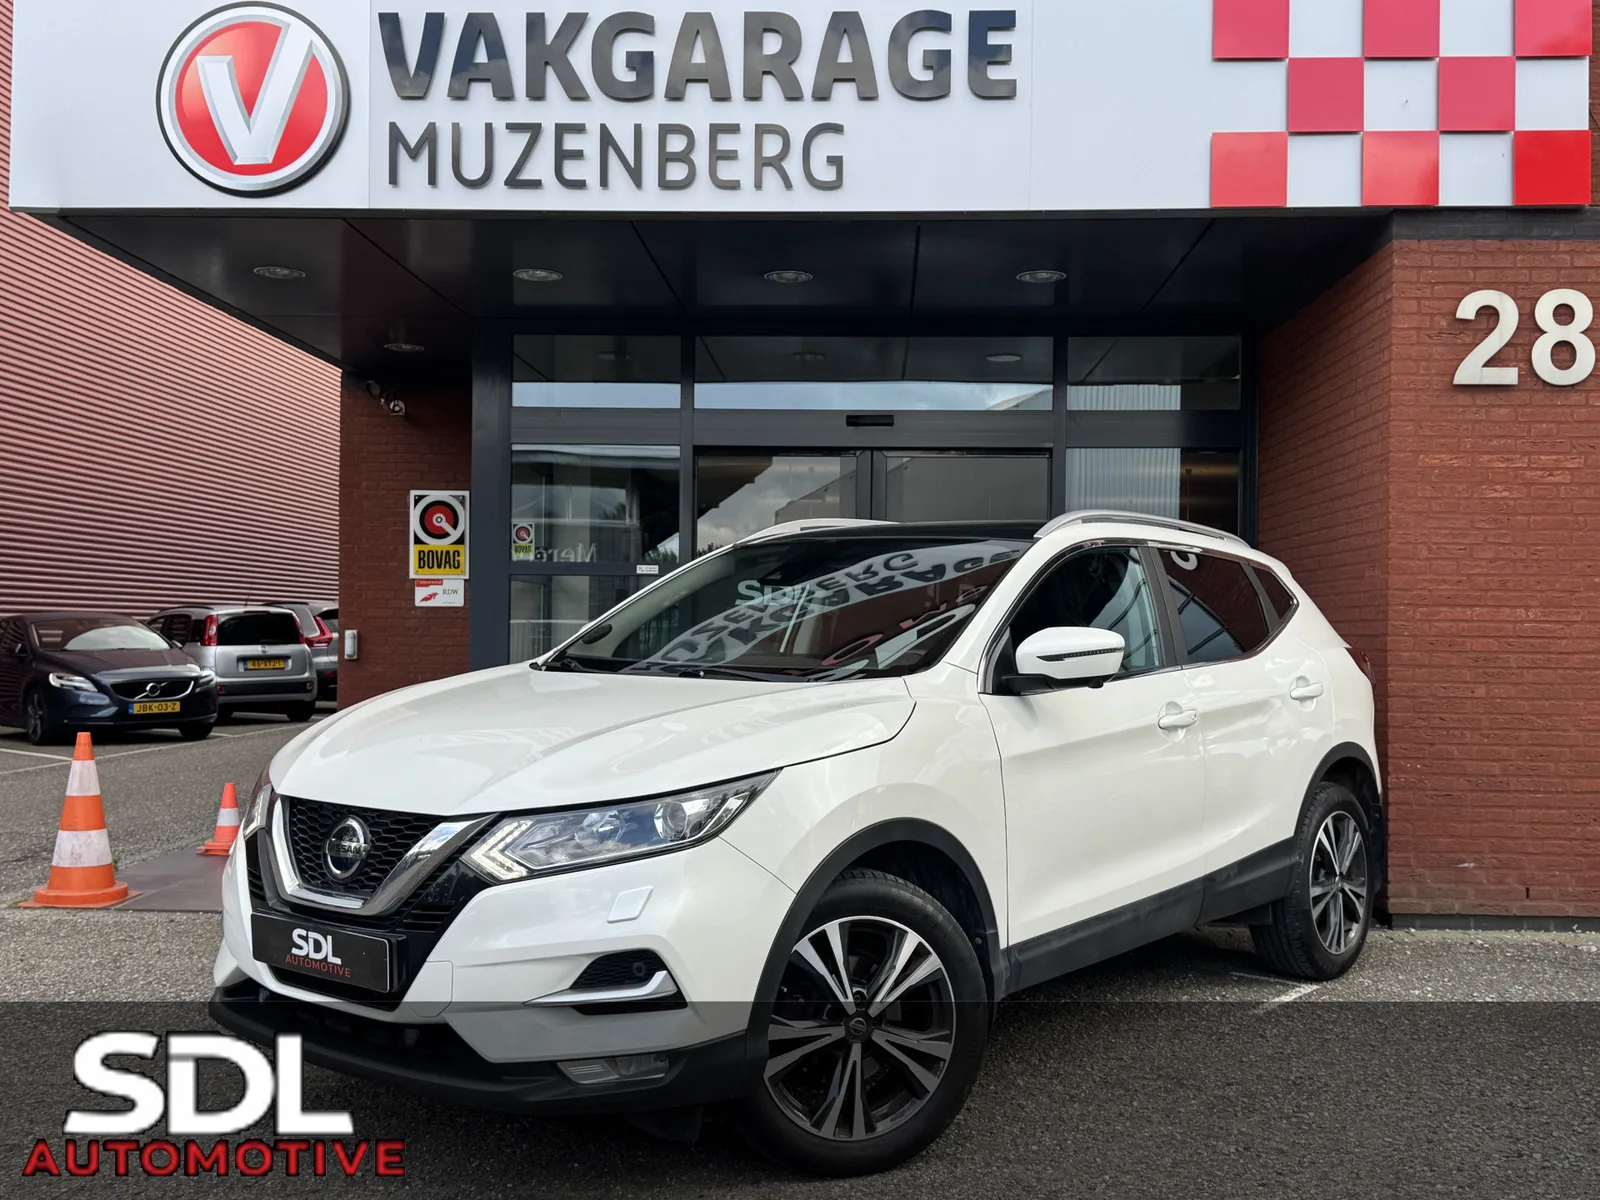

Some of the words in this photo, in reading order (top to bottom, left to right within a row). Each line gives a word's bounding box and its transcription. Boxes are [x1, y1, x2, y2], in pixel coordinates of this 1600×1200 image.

[378, 9, 1017, 101] VAKGARAGE
[388, 121, 845, 190] MUZENBERG
[1452, 288, 1596, 387] 28
[417, 549, 461, 570] BOVAG
[136, 702, 177, 712] JBK-03-Z
[291, 928, 342, 965] SDL
[285, 954, 351, 978] AUTOMOTIVE
